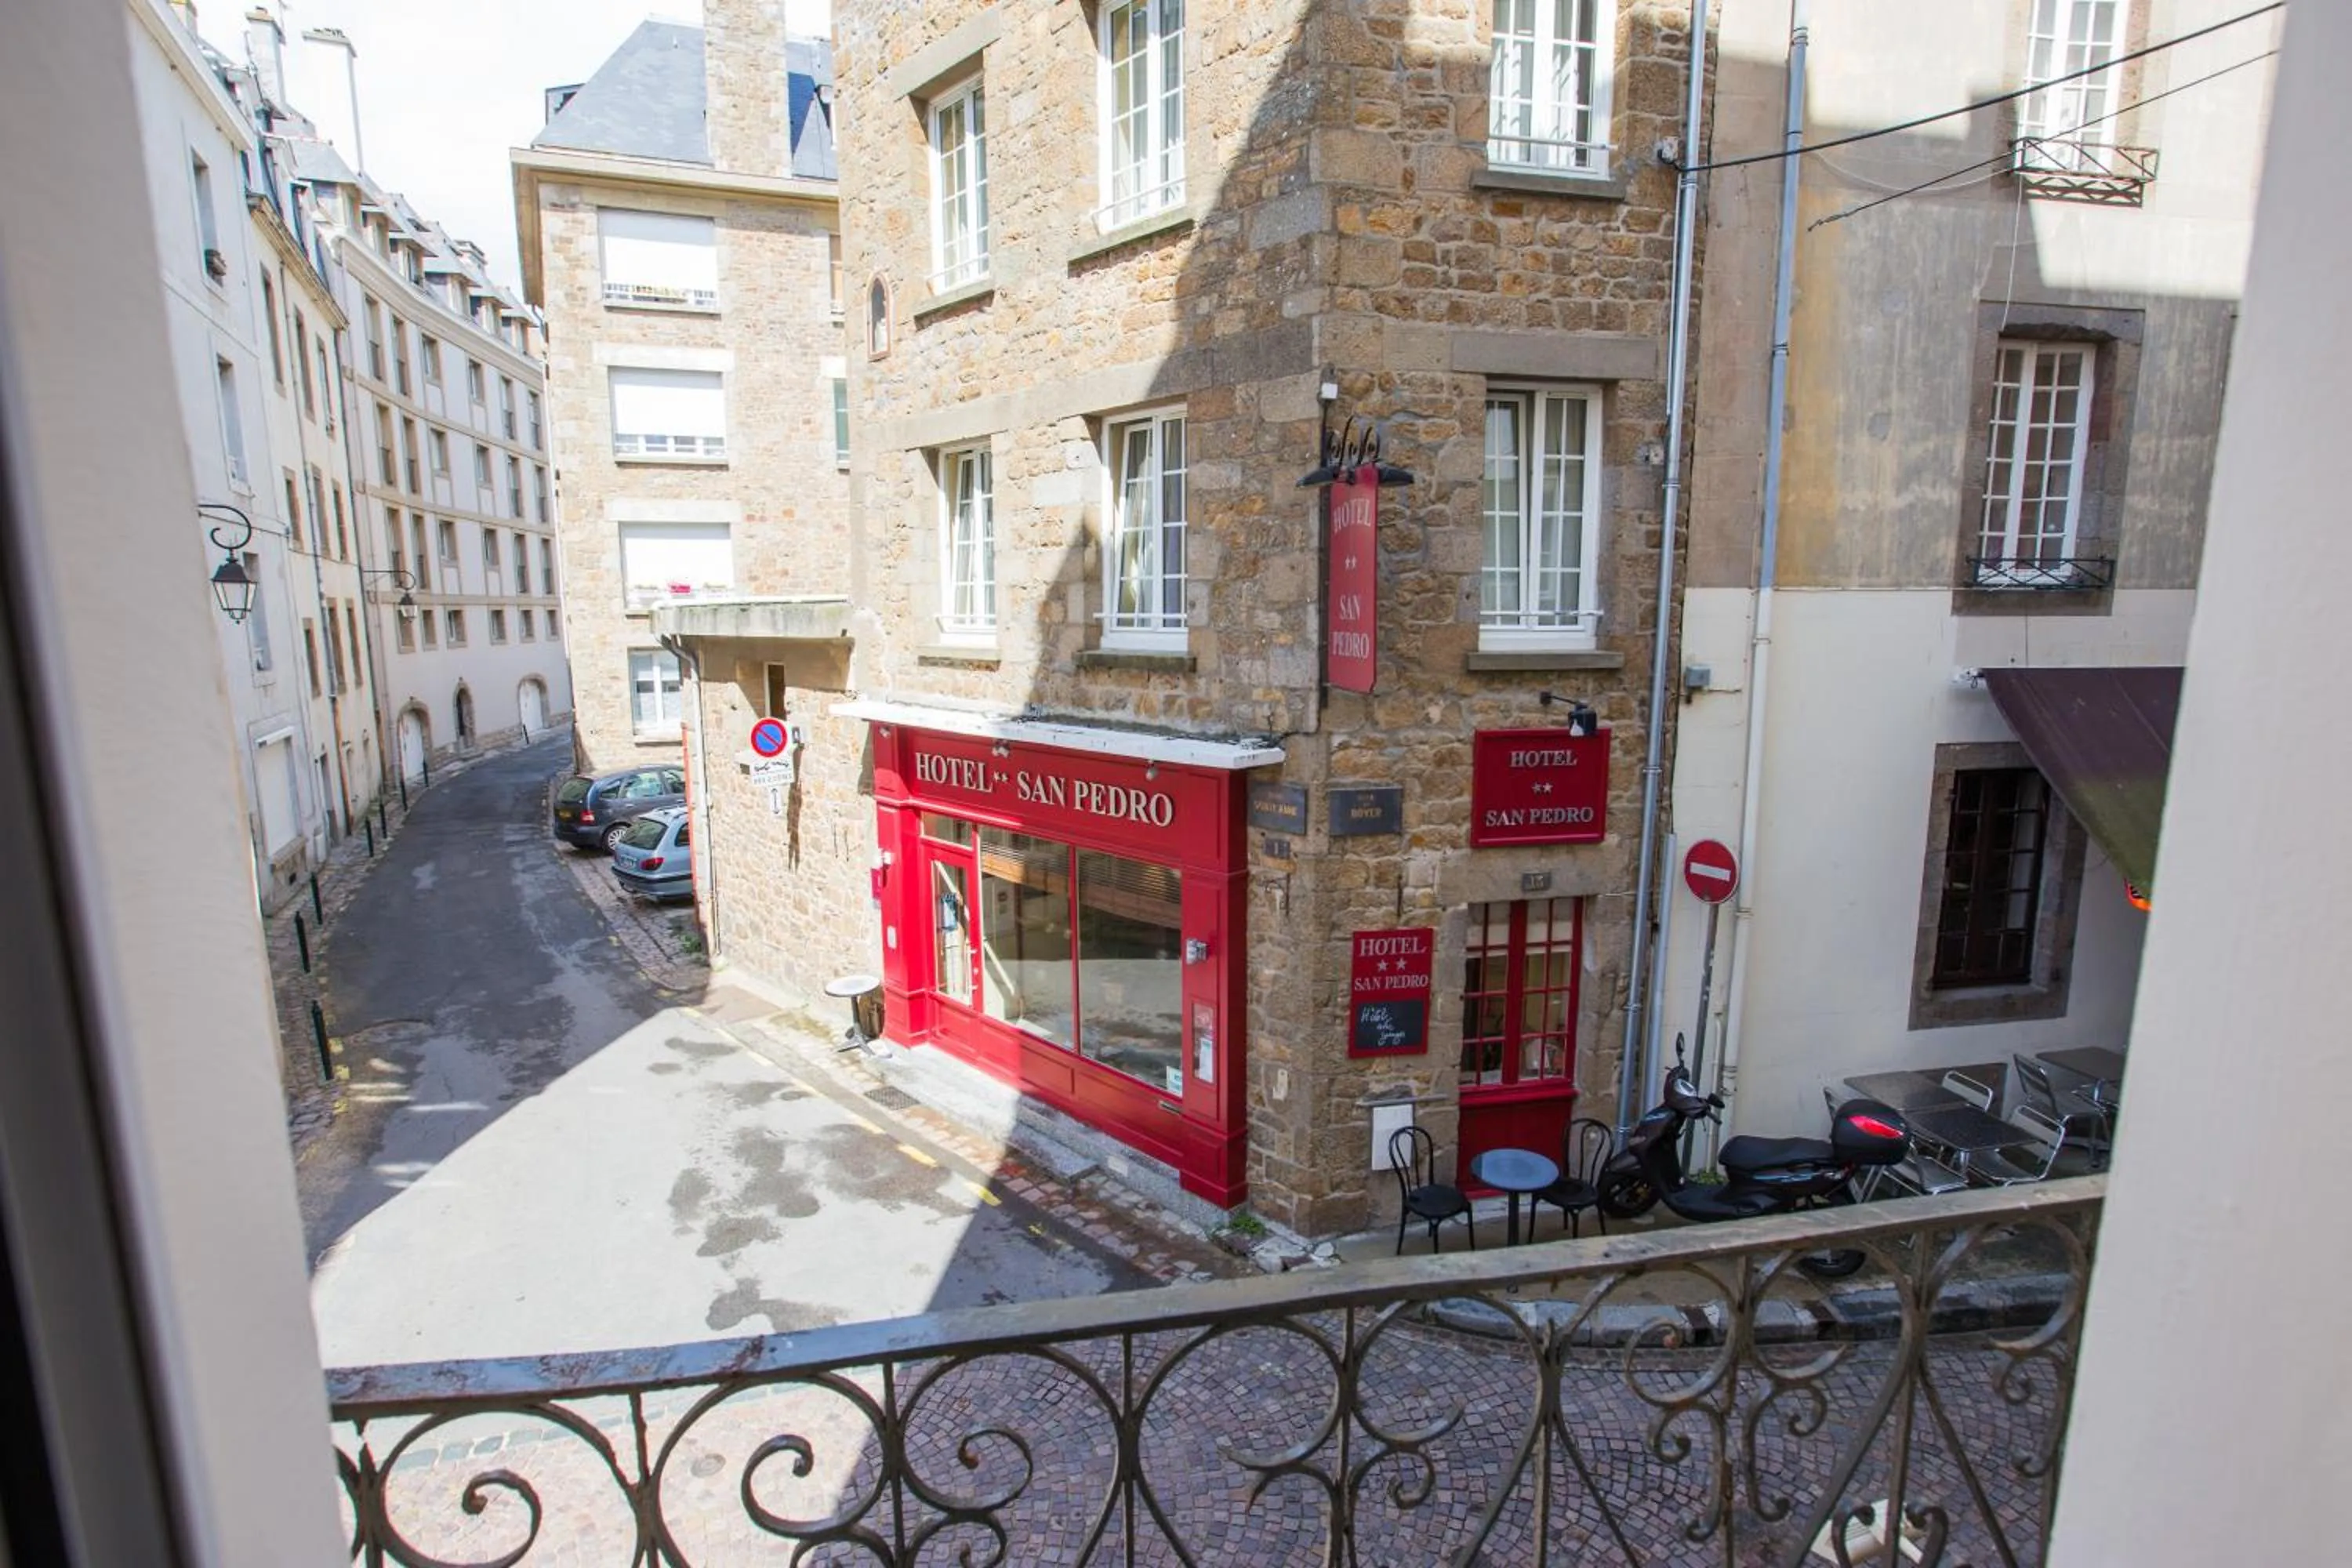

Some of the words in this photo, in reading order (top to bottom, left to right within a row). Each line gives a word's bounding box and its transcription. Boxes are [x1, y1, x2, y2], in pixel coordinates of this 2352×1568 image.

[1334, 498, 1371, 534] HOTEL
[1340, 595, 1361, 621] SAN
[1334, 631, 1370, 659] PEDRO
[1509, 750, 1579, 768] HOTEL
[915, 751, 993, 793] HOTEL
[1017, 771, 1066, 808] SAN
[1073, 780, 1174, 828] PEDRO
[1485, 809, 1525, 827] SAN
[1530, 806, 1595, 825] PEDRO
[1359, 937, 1427, 957] HOTEL
[1354, 975, 1381, 992] SAN
[1385, 975, 1429, 990] PEDRO
